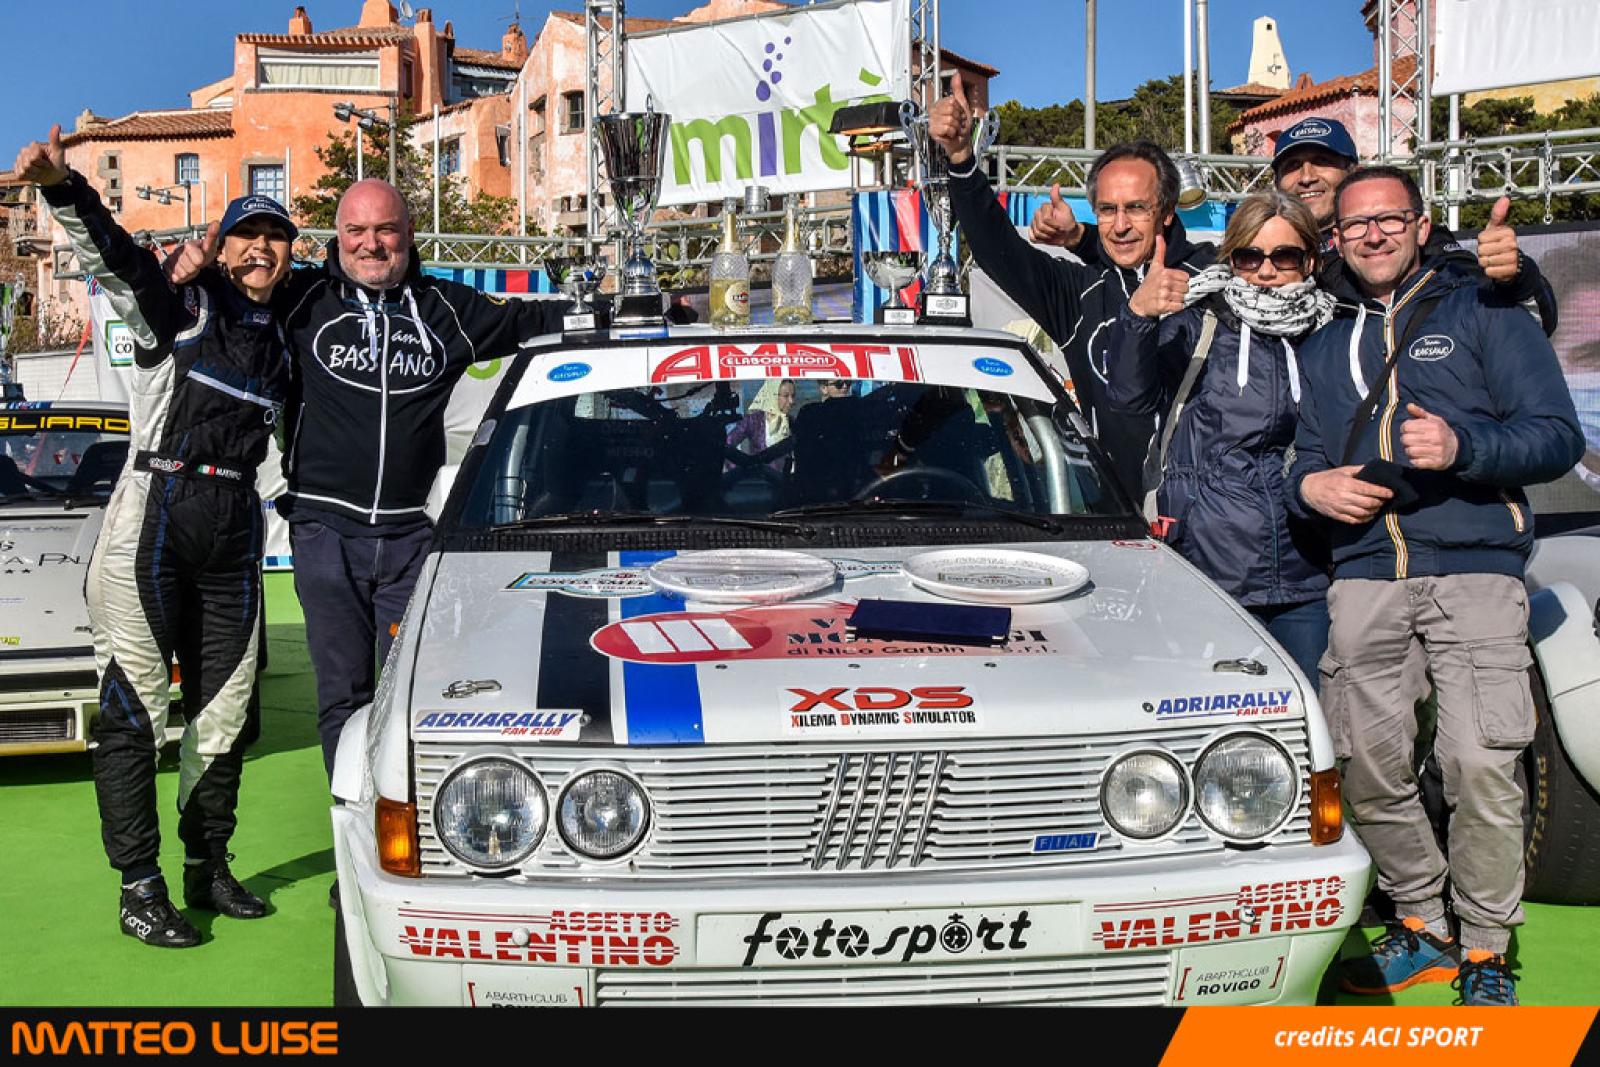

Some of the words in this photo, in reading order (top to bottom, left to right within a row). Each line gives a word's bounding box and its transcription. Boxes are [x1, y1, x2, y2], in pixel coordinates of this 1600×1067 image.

[652, 343, 920, 383] AMATI
[786, 686, 975, 712] XDS
[1156, 690, 1292, 715] ADRIARALLY
[416, 711, 578, 728] ADRIARALLY
[791, 713, 837, 728] XILEMA
[841, 712, 900, 726] DYNAMIC
[903, 711, 976, 725] SIMULATOR
[1235, 707, 1259, 717] FAN
[1038, 834, 1094, 849] FIAT
[1236, 875, 1343, 906] ASSETTO
[550, 910, 674, 933] ASSETTO
[1101, 897, 1342, 950] VALENTINO
[403, 925, 676, 966] VALENTINO
[742, 910, 1032, 967] fotosport
[1196, 965, 1270, 982] ABARTHCLUB
[484, 990, 568, 1004] ABARTHCLUB
[1196, 979, 1262, 996] ROVIGO
